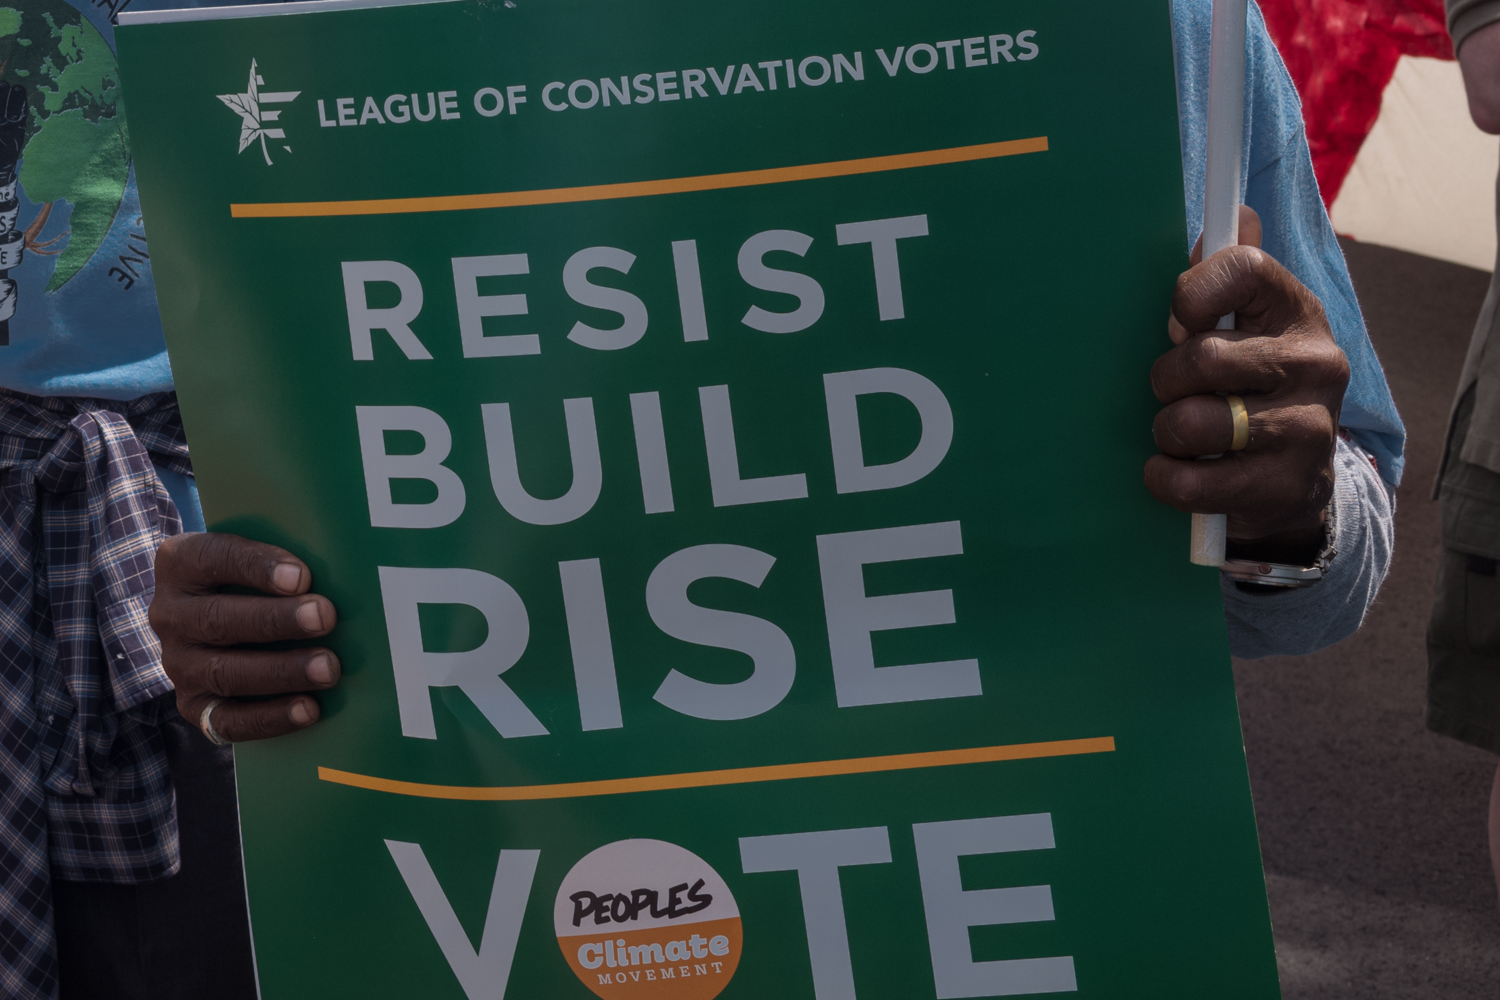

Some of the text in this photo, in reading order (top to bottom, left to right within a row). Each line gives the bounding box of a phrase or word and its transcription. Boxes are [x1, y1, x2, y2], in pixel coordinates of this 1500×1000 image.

[317, 29, 1040, 129] LEAGUE OF CONSERVATION VOTERS
[340, 214, 929, 361] RESIST
[355, 367, 954, 529] BUILD
[377, 520, 983, 740] RISE
[569, 878, 713, 927] PEOPLES
[577, 934, 730, 969] Climate
[597, 962, 723, 985] MOVEMENT
